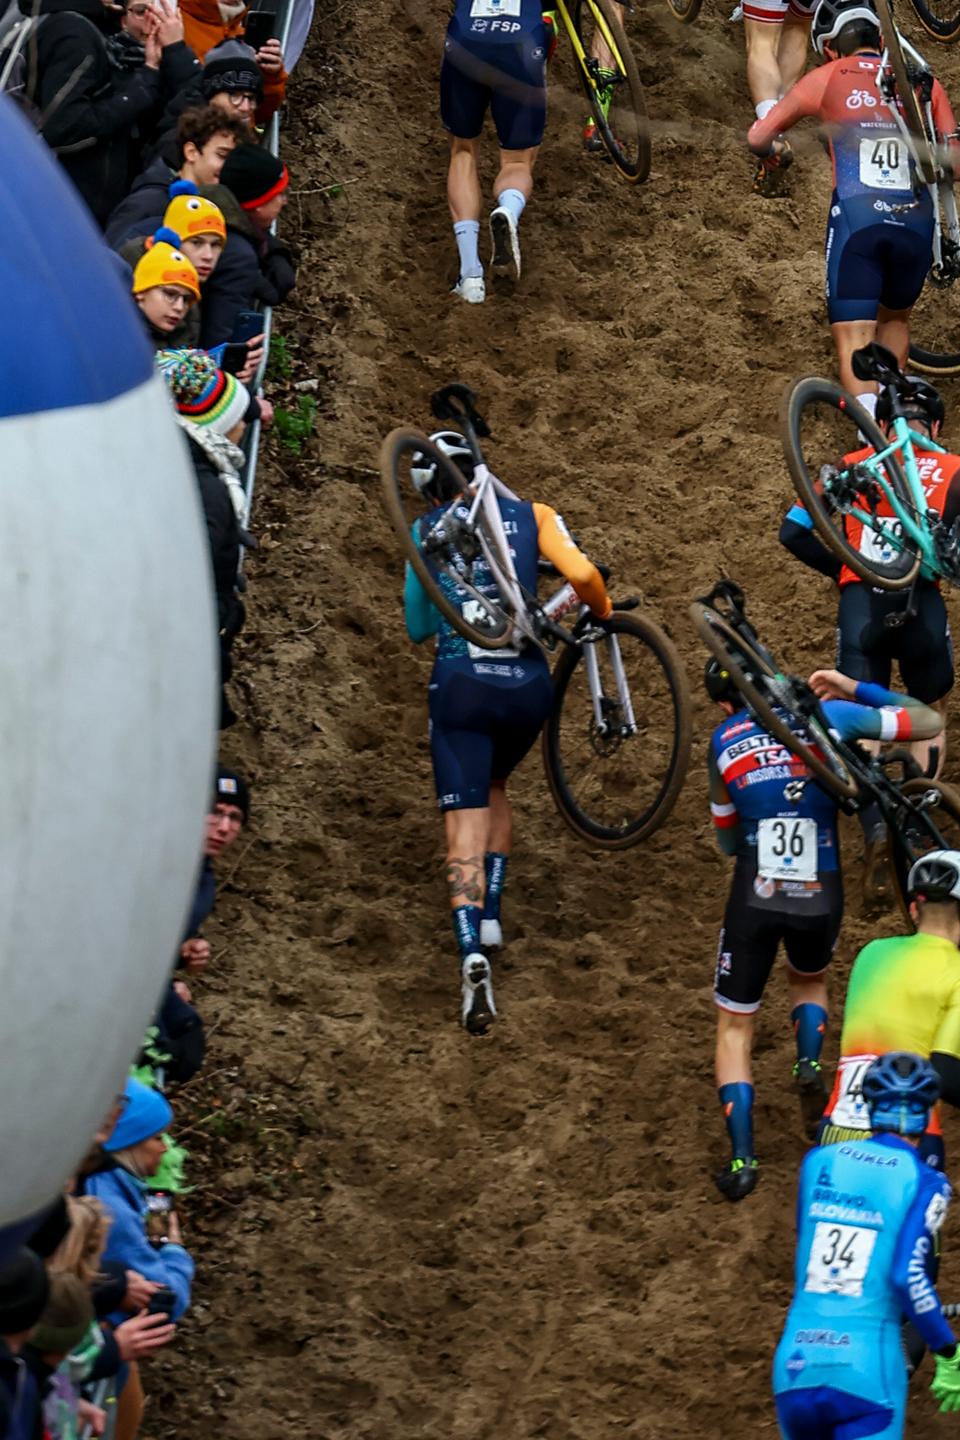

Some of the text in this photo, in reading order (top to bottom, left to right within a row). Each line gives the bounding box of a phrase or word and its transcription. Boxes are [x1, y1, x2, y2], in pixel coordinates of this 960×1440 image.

[490, 19, 521, 34] FSP
[871, 140, 899, 169] 40
[755, 748, 792, 766] TSA
[772, 820, 805, 857] 36
[837, 1143, 899, 1169] DUKLA
[809, 1203, 885, 1226] SLOVAKIA
[821, 1227, 859, 1269] 34
[907, 1236, 938, 1316] BRUVO
[794, 1328, 851, 1347] DUKLA
